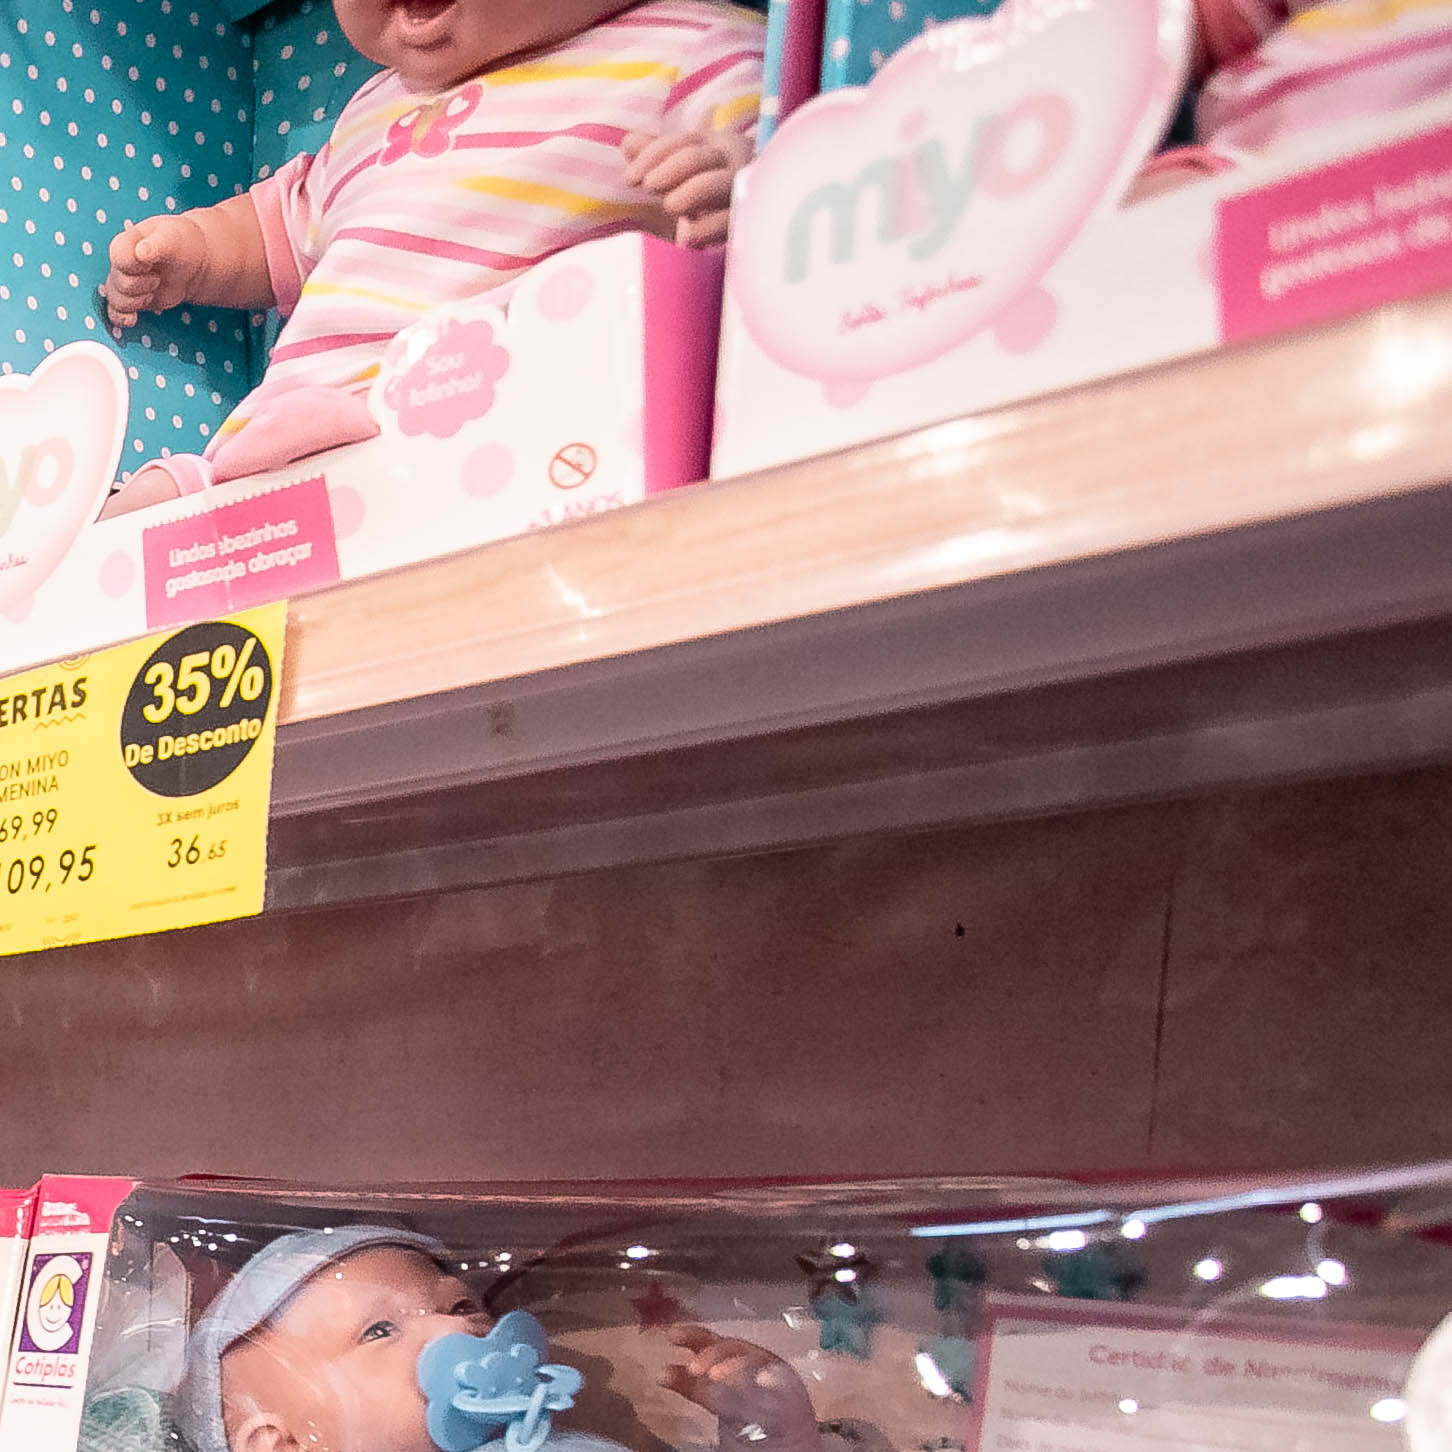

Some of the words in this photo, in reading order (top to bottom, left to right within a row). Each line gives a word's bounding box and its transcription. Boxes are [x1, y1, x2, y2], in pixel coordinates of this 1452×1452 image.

[783, 92, 1073, 285] miyo
[168, 541, 217, 568] Lindos
[218, 518, 299, 555] bezinhos
[165, 563, 225, 599] gostoso
[248, 541, 314, 574] abraçar
[141, 636, 265, 725] 35%
[25, 749, 70, 776] MIYO
[123, 742, 155, 768] De
[157, 717, 263, 761] Desconto
[176, 807, 205, 824] sem
[206, 800, 241, 822] juros
